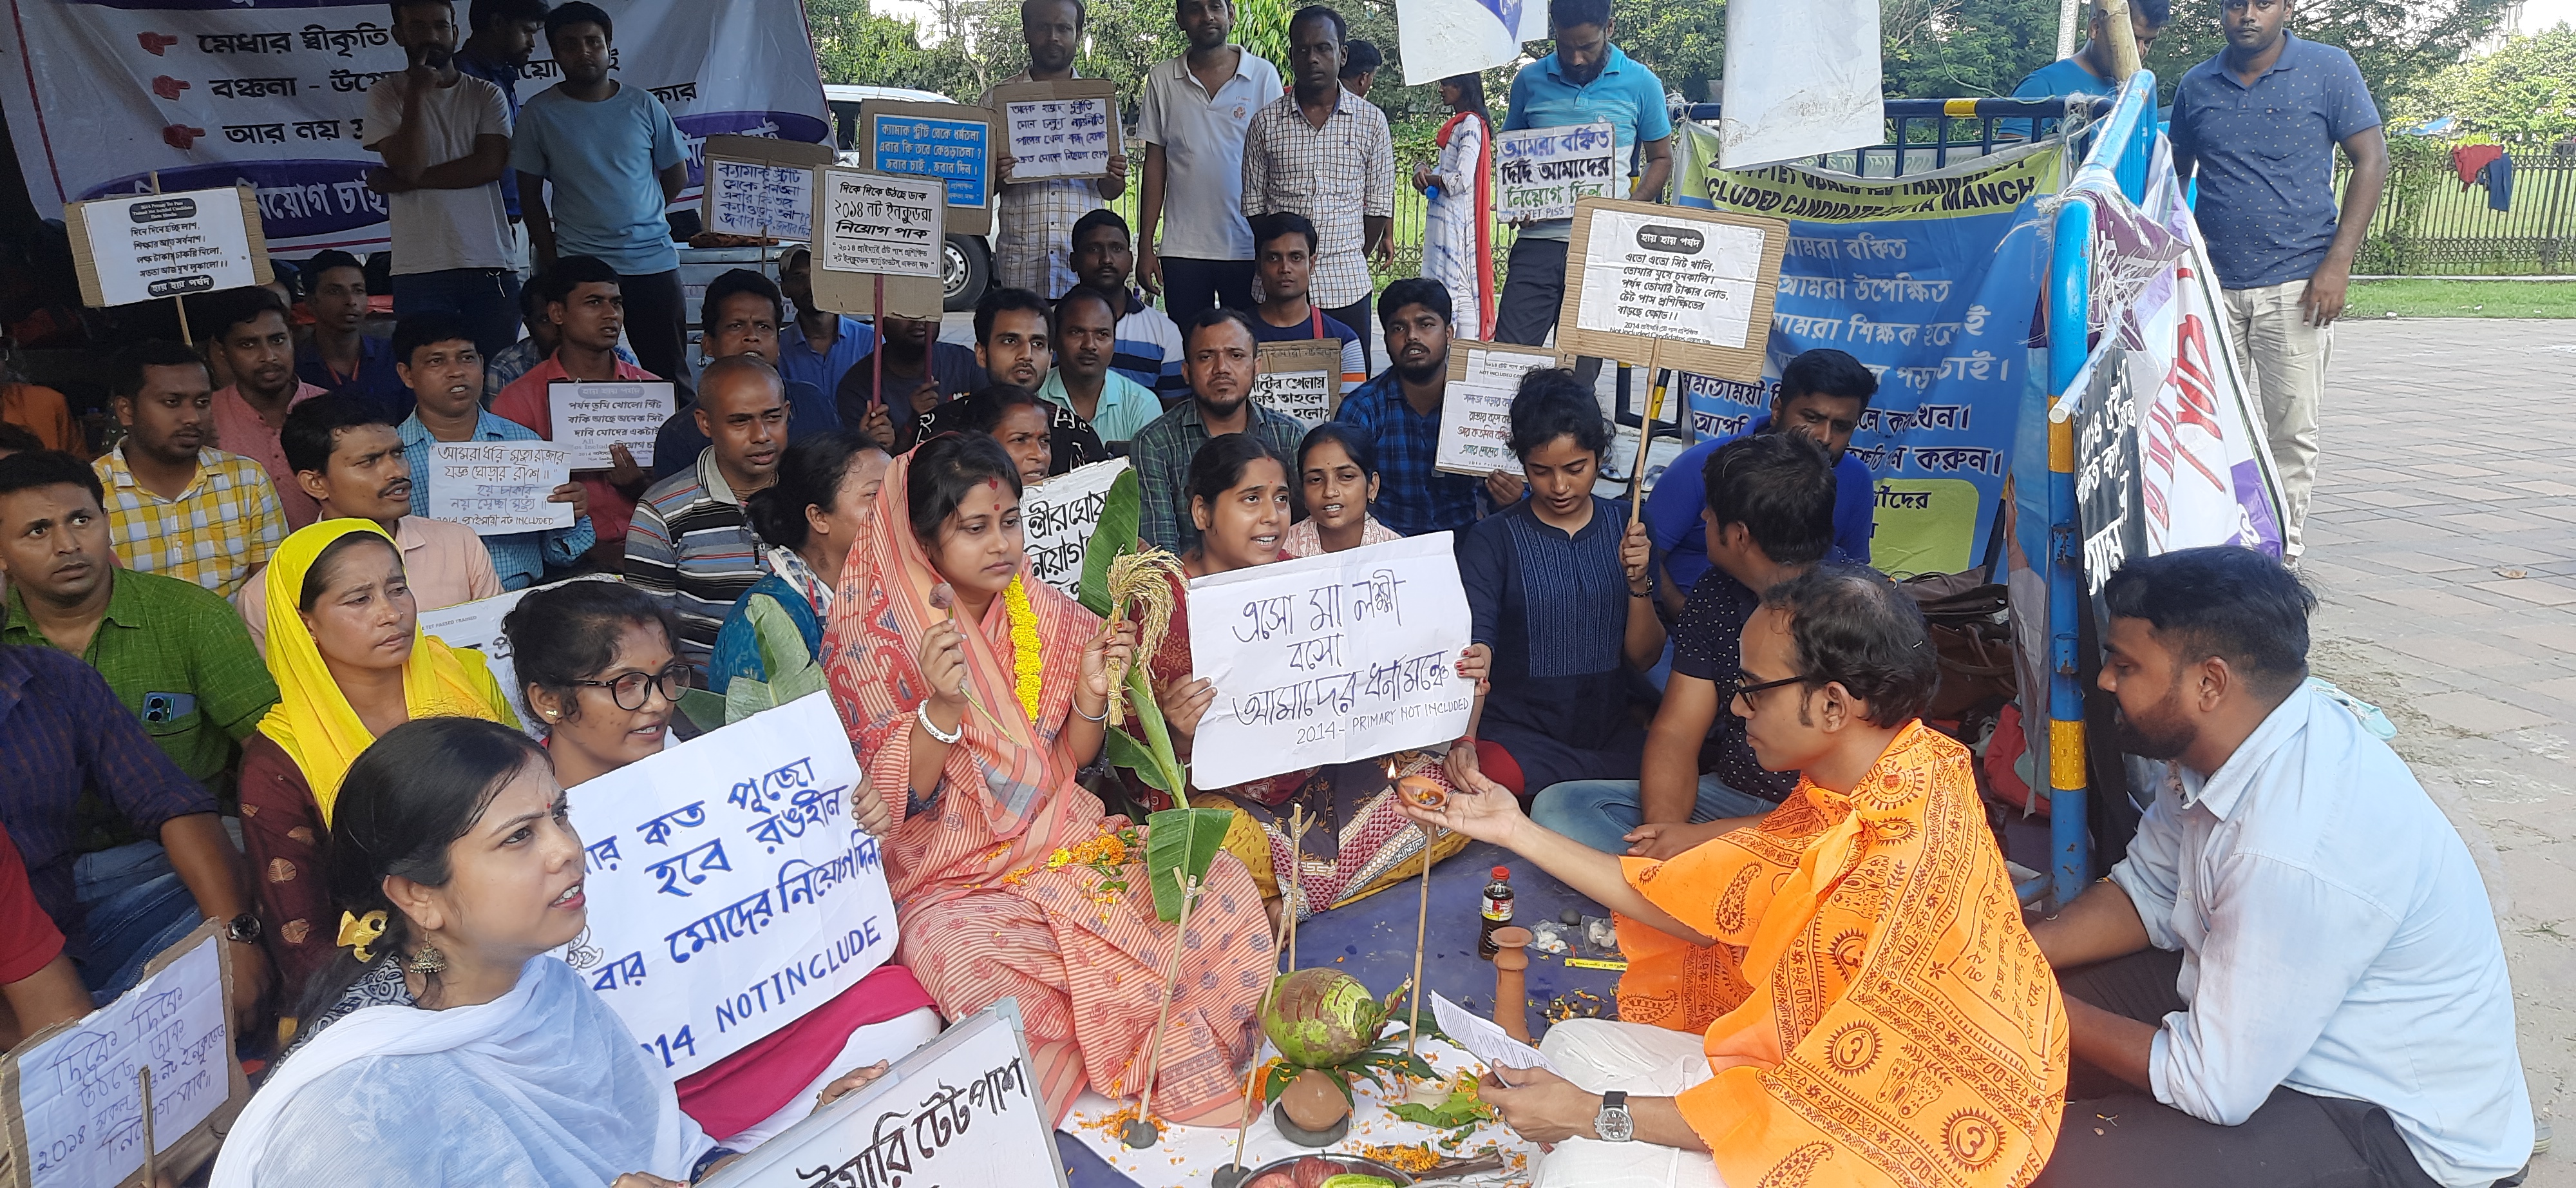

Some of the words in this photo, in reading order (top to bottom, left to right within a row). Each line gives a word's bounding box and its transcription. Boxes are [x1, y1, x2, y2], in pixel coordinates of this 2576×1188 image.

[196, 33, 291, 53] মেধার
[222, 123, 286, 144] আর
[292, 120, 340, 141] নয়
[932, 128, 952, 140] থেকে
[879, 141, 900, 153] এবার
[902, 140, 913, 154] কি
[1500, 135, 1558, 157] আমরা
[1537, 157, 1612, 180] আমাদের
[840, 182, 862, 195] দিকে
[862, 184, 884, 196] দিকে
[886, 187, 907, 200] উঠছে
[908, 191, 928, 202] ডাক
[866, 200, 883, 217] নট
[835, 220, 892, 236] নিয়োগ
[895, 227, 931, 239] পাক
[1640, 233, 1657, 244] হায়
[1660, 235, 1676, 245] হায়
[1847, 312, 1921, 347] শিক্ষক
[1232, 594, 1296, 642] এসো
[1309, 584, 1343, 630] মা
[1287, 633, 1344, 671] বসো
[1233, 669, 1365, 725] আমাদের
[1352, 711, 1396, 736] PRIMARY
[1401, 704, 1421, 720] NOT
[1424, 697, 1470, 717] INCLUDED
[636, 800, 705, 847] কত
[644, 837, 733, 897] হবে
[581, 952, 647, 991] বার
[664, 888, 775, 964] মোদের
